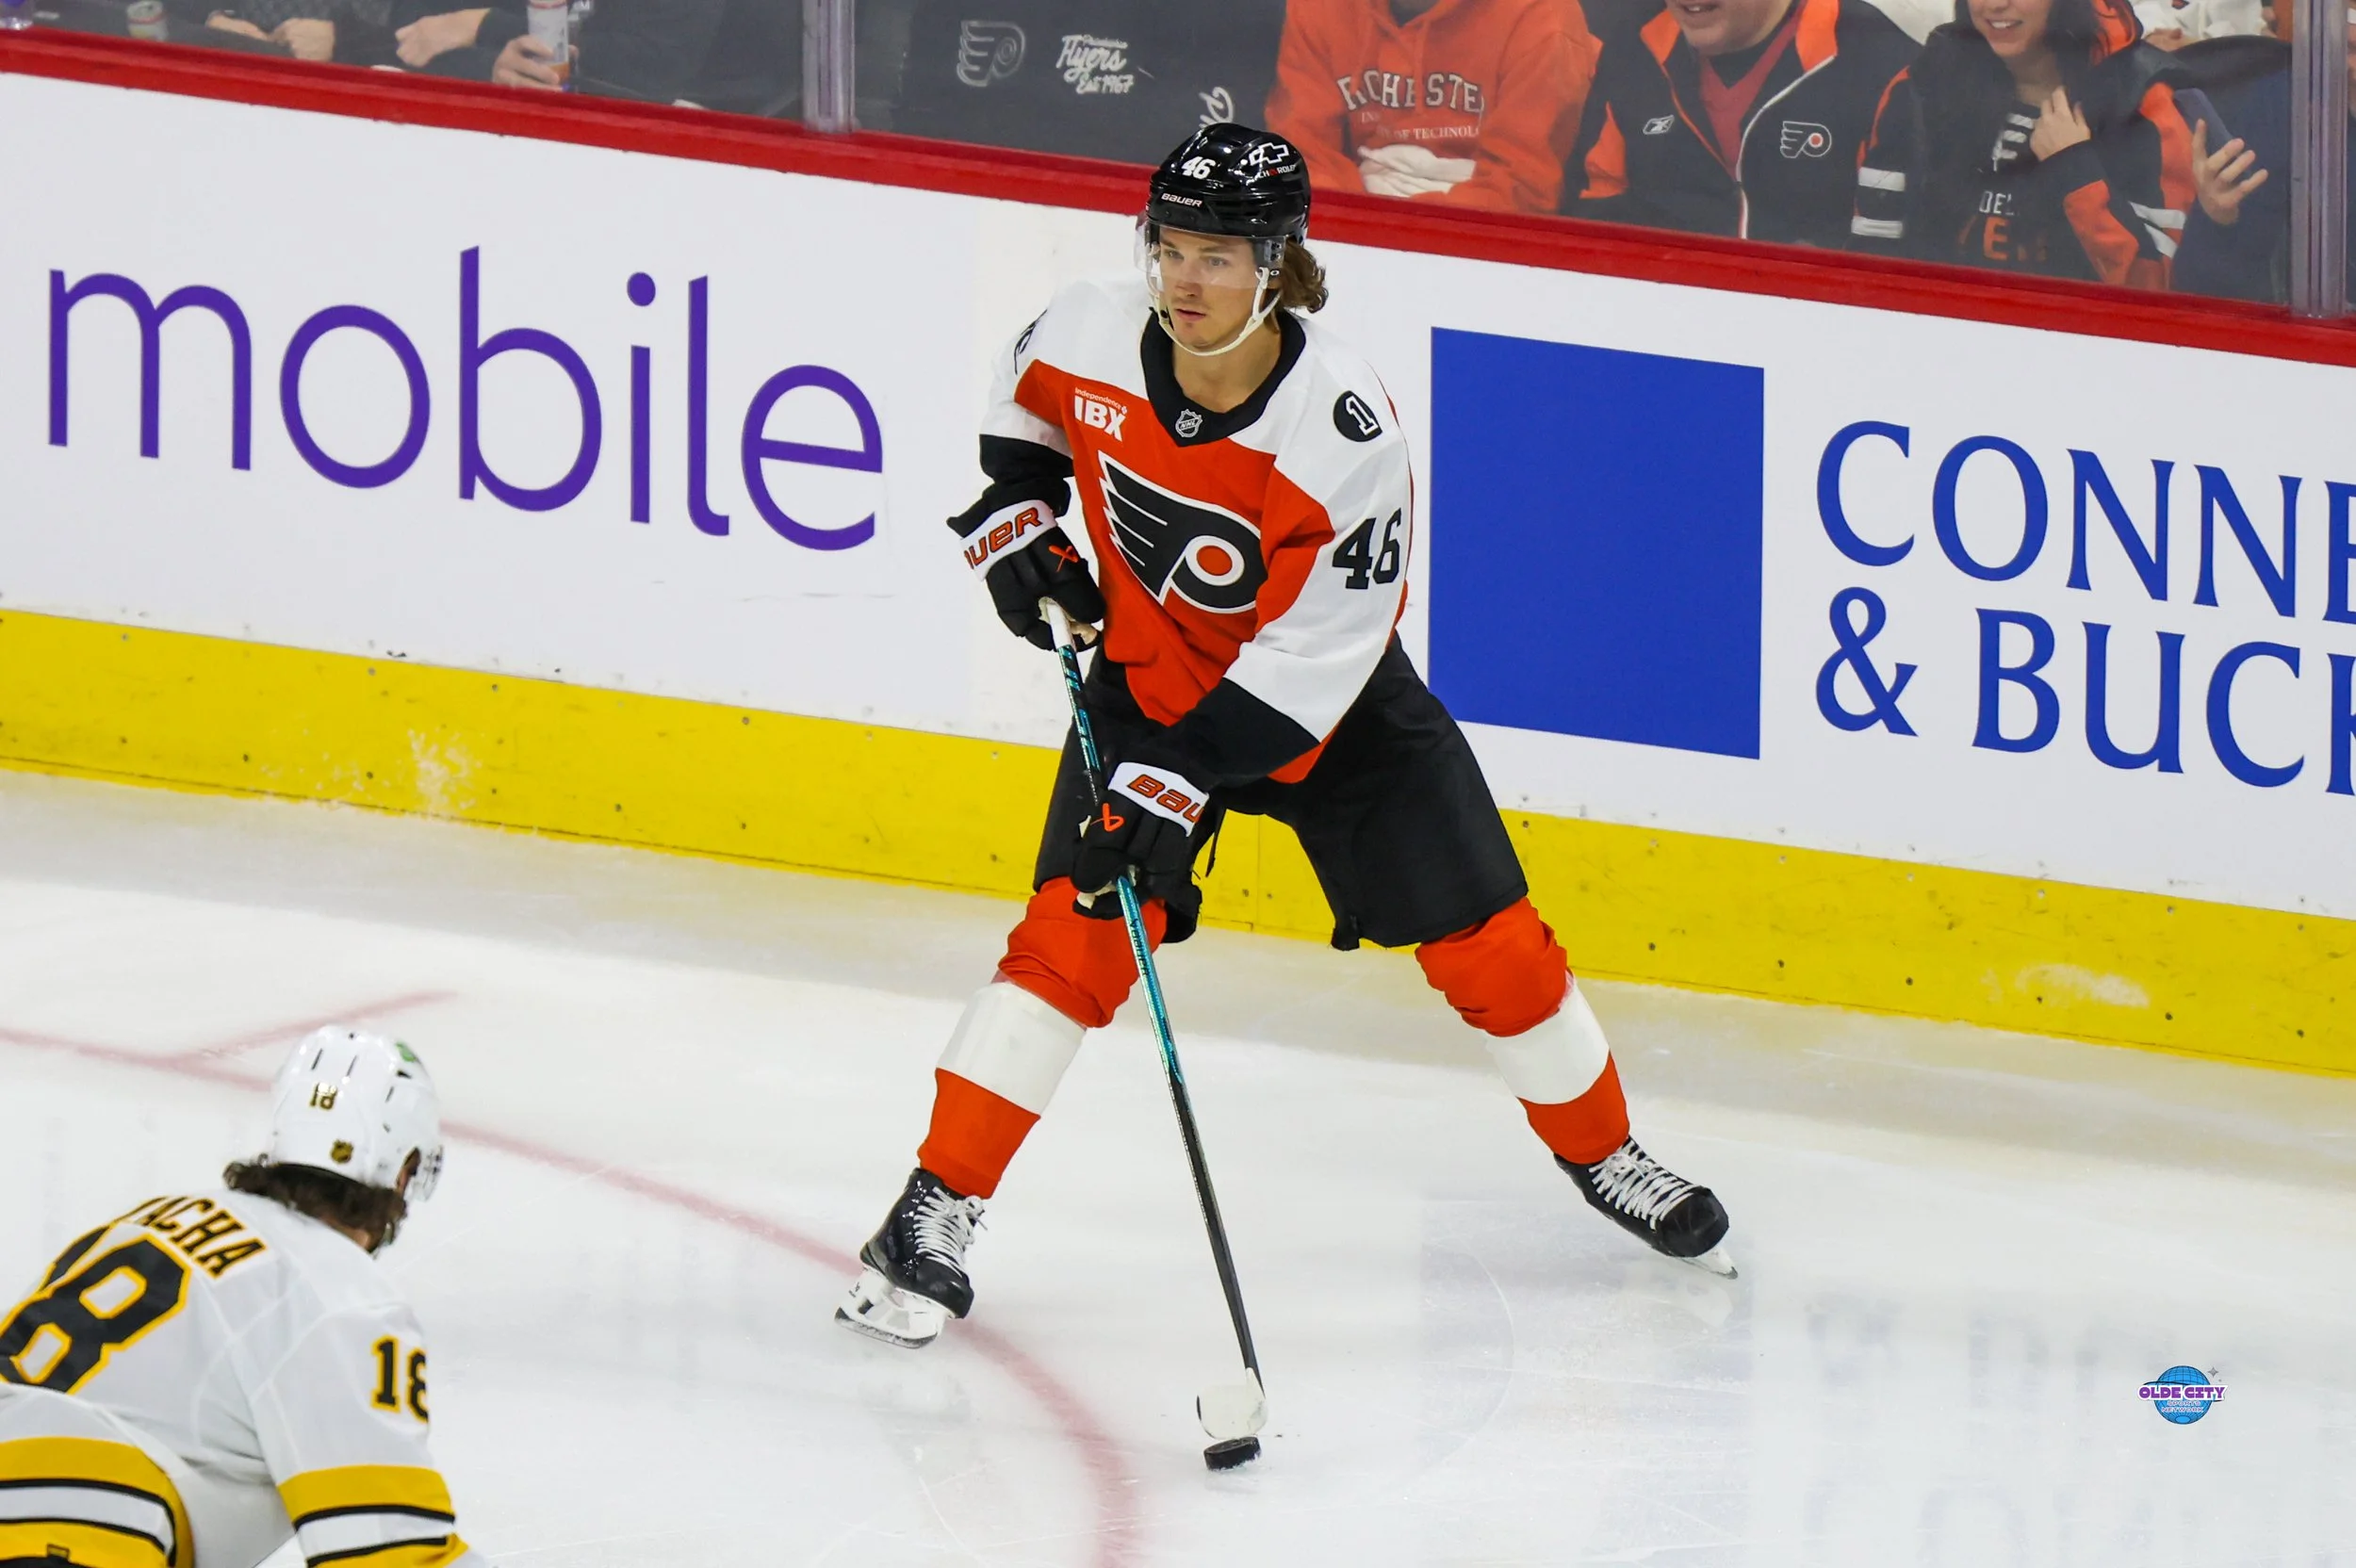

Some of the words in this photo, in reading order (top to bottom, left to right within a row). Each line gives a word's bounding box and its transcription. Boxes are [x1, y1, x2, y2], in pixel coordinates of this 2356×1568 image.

[1182, 156, 1216, 179] 46
[49, 246, 883, 550] mobile
[1074, 387, 1121, 411] Independence
[1074, 395, 1125, 442] IBX
[1346, 395, 1378, 435] 1
[964, 507, 1042, 569] UER
[1332, 507, 1402, 589] 46
[1816, 587, 1919, 737] &
[309, 1081, 338, 1110] 18
